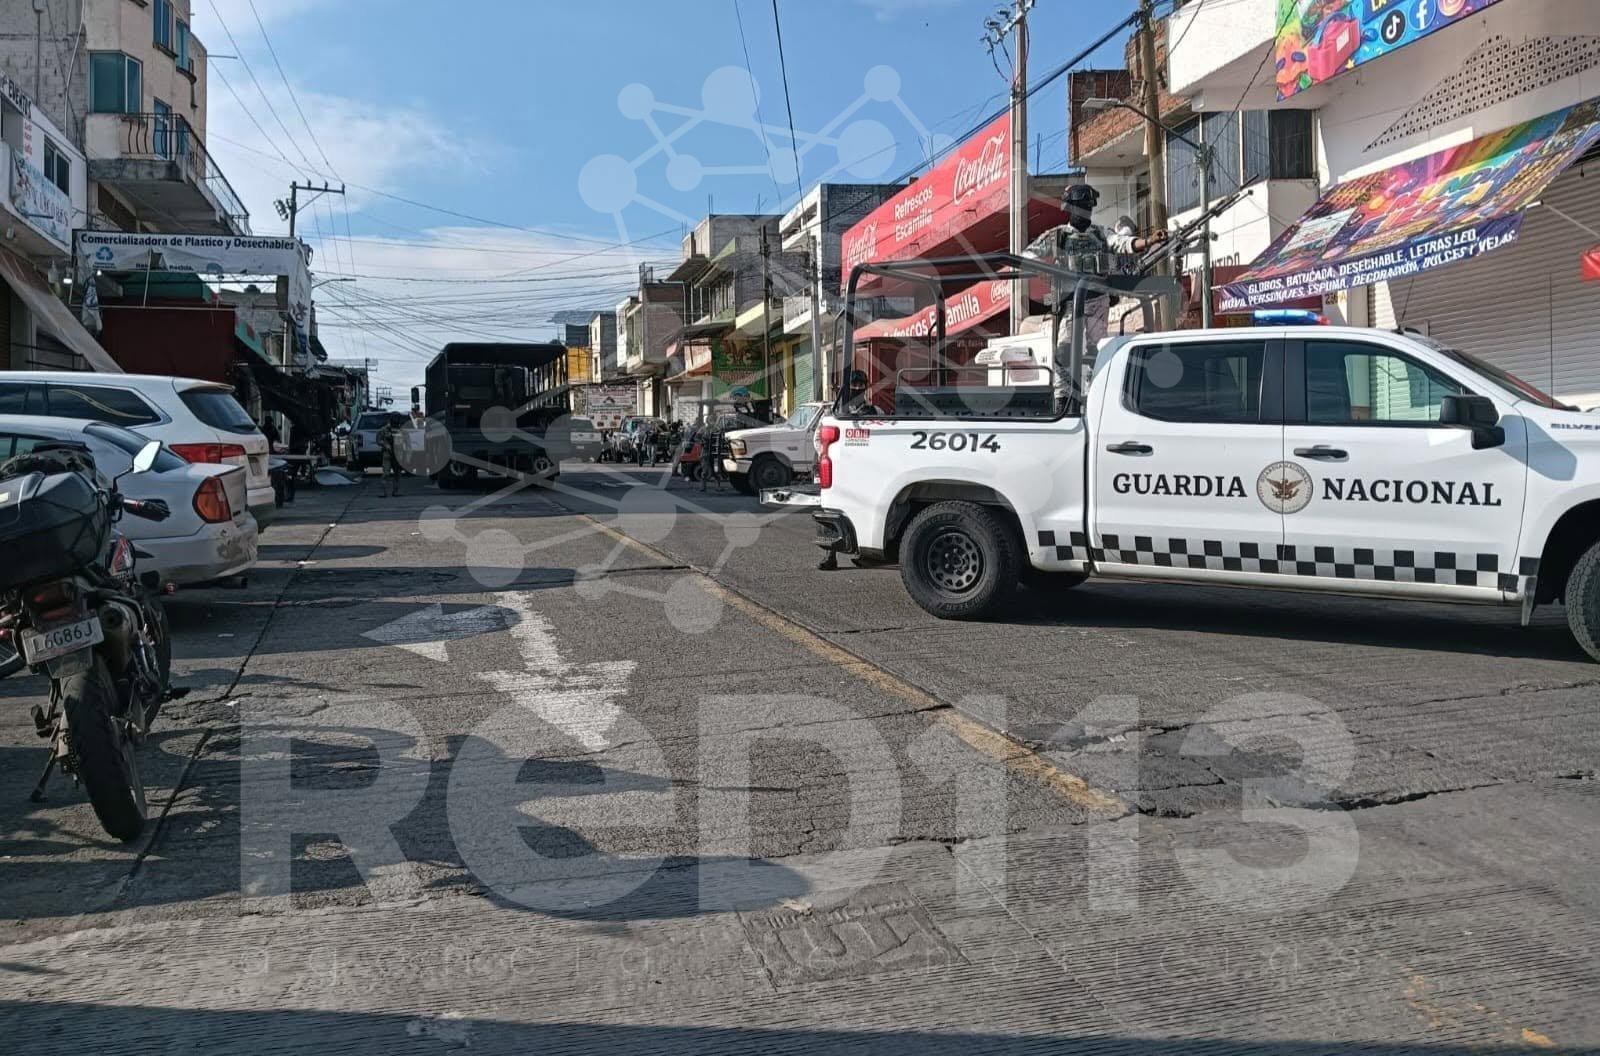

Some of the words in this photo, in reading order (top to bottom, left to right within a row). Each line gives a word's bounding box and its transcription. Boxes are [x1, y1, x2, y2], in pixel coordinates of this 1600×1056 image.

[894, 185, 934, 221] Refrescos
[895, 208, 934, 242] Escamilla
[81, 232, 168, 247] Comercializadora
[169, 234, 183, 247] de
[225, 239, 232, 249] y
[234, 236, 295, 251] Desechables
[1248, 277, 1285, 295] GLOBOS,
[1339, 249, 1408, 276] DESECHABLE,
[1409, 235, 1454, 260] LETRAS
[929, 296, 980, 332] Eamilla
[910, 430, 1002, 454] 26014
[1112, 473, 1248, 498] GUARDIA
[1322, 478, 1502, 507] NACIONAL
